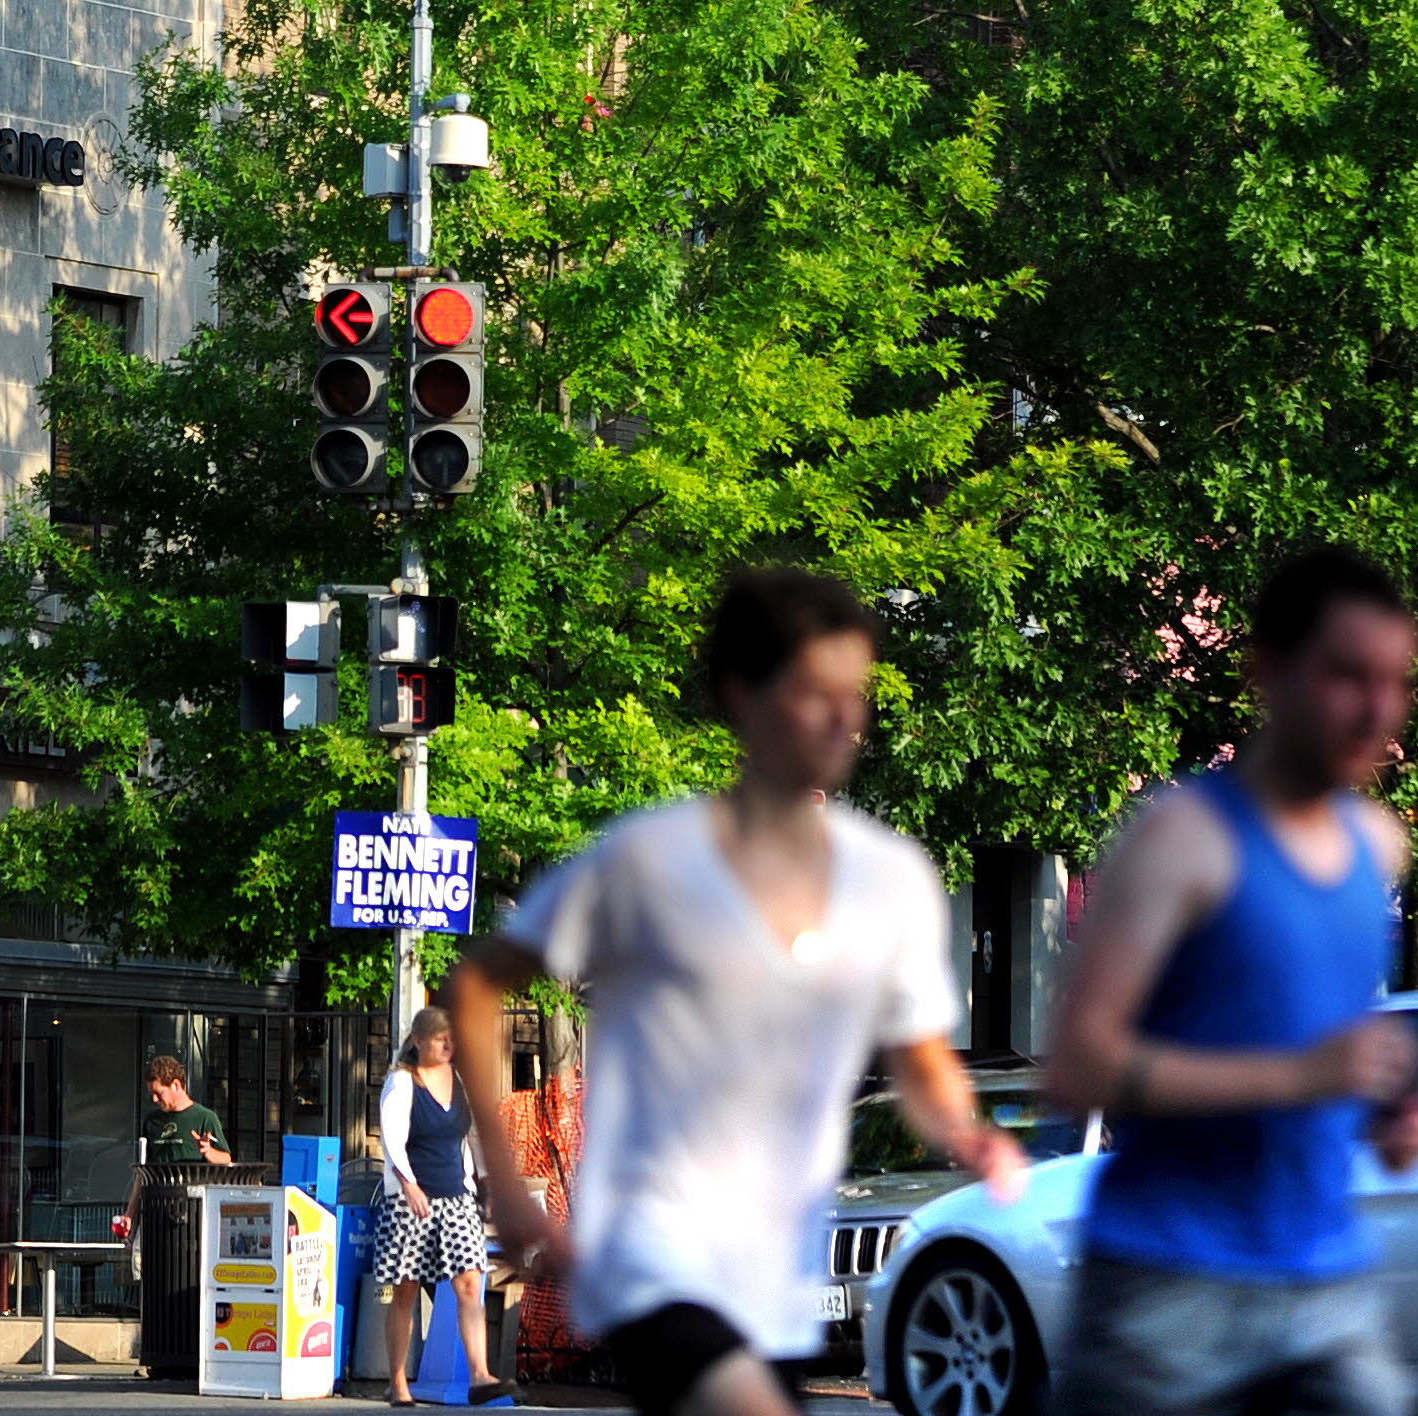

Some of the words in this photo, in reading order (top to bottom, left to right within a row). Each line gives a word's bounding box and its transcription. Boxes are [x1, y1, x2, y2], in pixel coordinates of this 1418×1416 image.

[338, 834, 473, 875] BENNETT
[336, 870, 470, 912] FLEMING
[353, 907, 384, 923] FOR
[388, 909, 417, 925] U.S.
